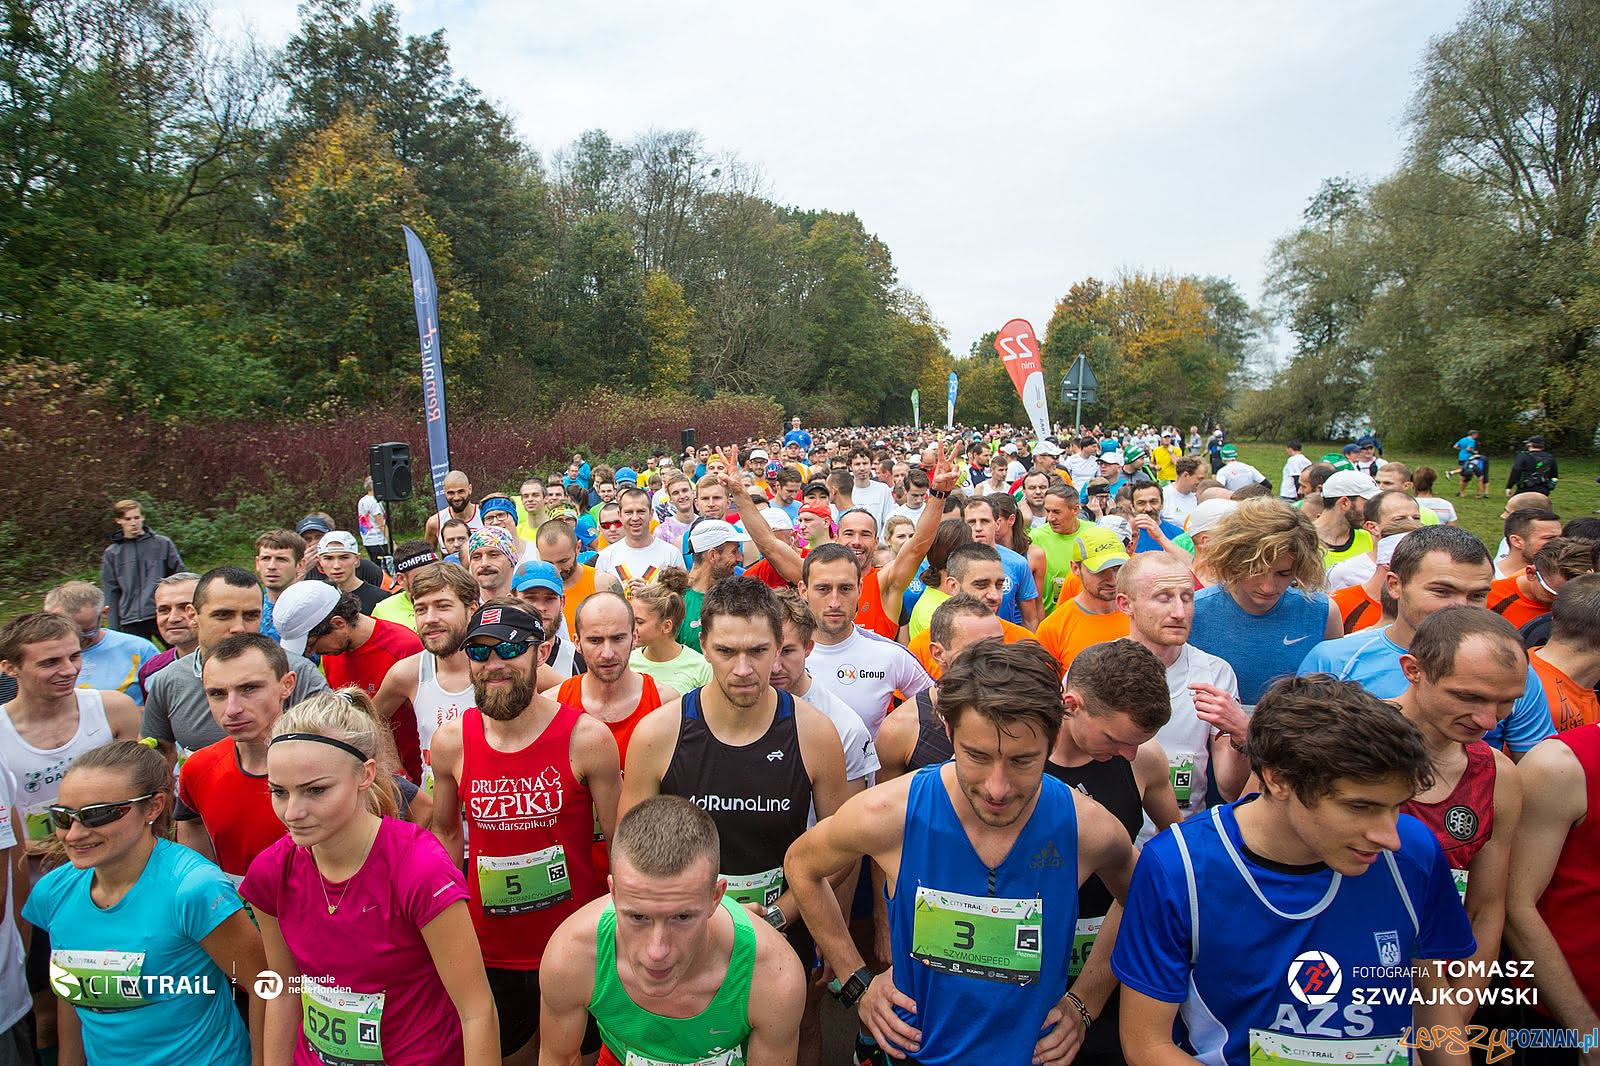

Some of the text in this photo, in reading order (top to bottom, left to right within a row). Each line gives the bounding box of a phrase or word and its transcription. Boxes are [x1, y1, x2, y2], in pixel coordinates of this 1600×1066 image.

[860, 669, 885, 680] Group
[471, 776, 545, 794] DRUŻYNA
[470, 790, 563, 818] SZPIKU
[477, 816, 557, 831] www.darszpiku.pl
[505, 875, 522, 895] 5
[953, 920, 976, 950] 3
[943, 949, 1010, 966] SZYMONSPEED
[308, 1005, 347, 1046] 626
[1268, 1002, 1374, 1038] AZS
